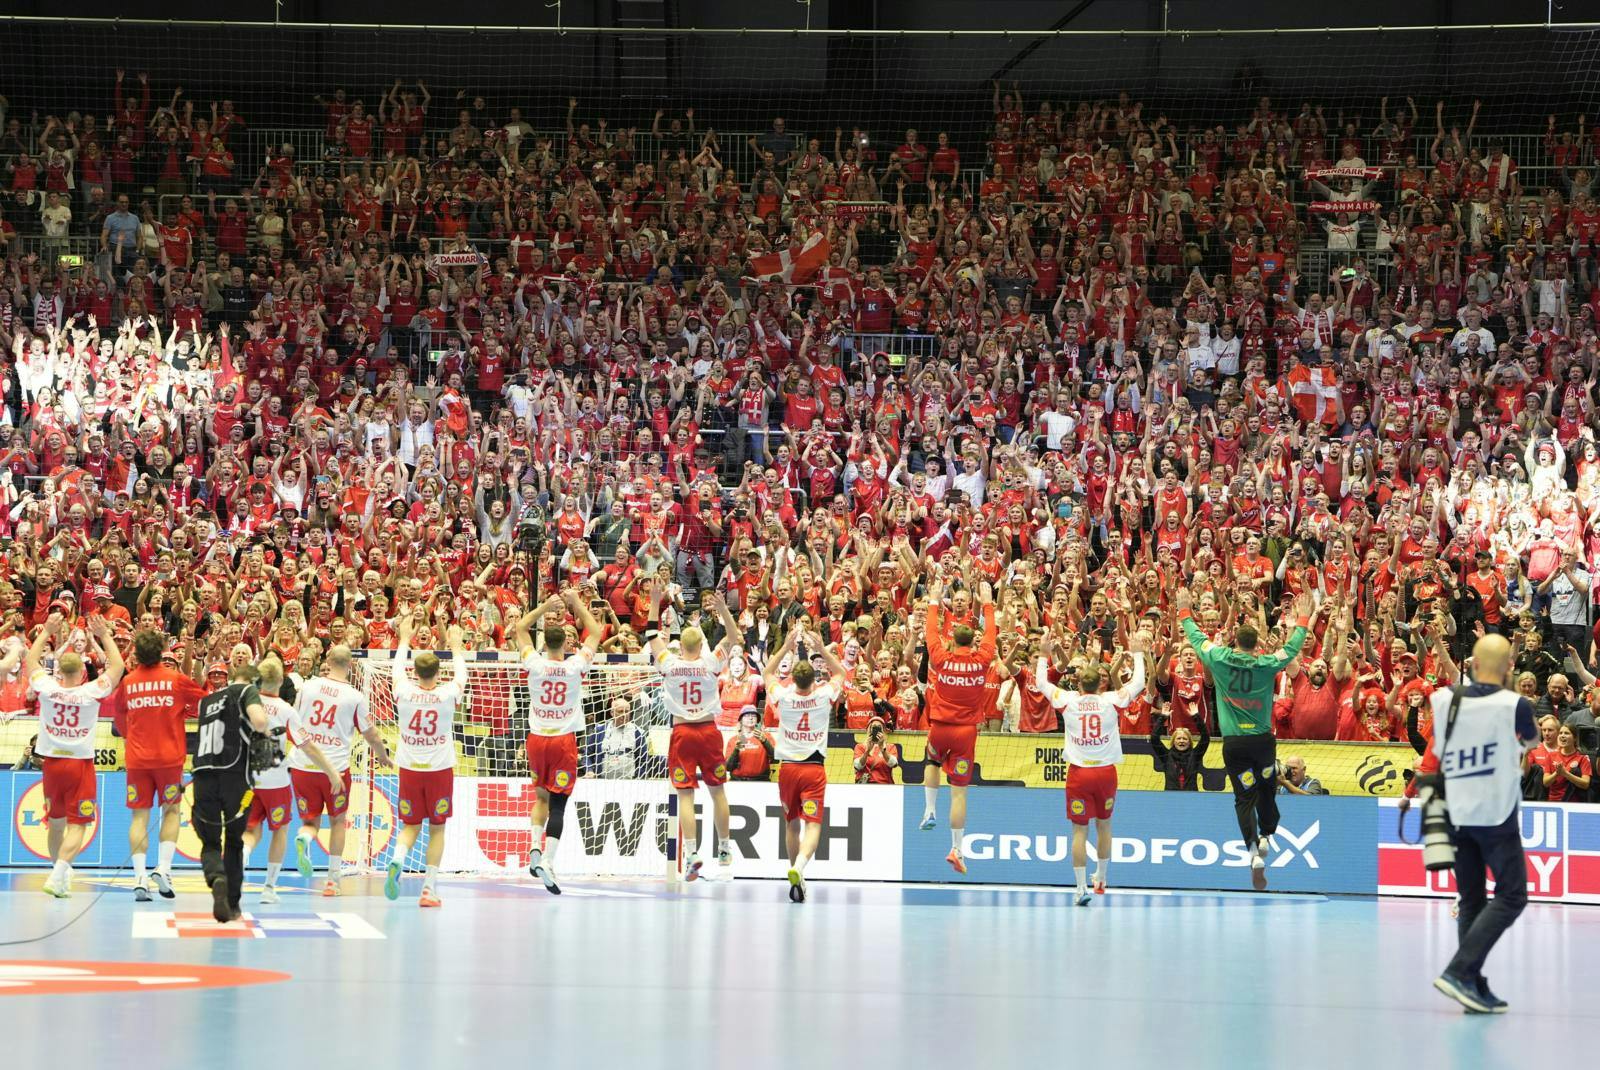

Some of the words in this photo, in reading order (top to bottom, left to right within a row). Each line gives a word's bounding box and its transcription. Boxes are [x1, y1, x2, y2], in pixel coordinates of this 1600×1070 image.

[1319, 167, 1364, 176] DANMARK
[1325, 202, 1375, 211] DANMARK
[938, 674, 985, 687] NORLYS
[1227, 667, 1253, 693] 20
[127, 695, 174, 710] NORLYS
[540, 680, 567, 706] 38
[679, 681, 702, 705] 15
[53, 702, 80, 728] 33
[310, 699, 337, 729] 34
[408, 709, 438, 736] 43
[797, 711, 811, 731] 4
[785, 730, 824, 741] NORLYS
[1079, 714, 1101, 738] 19
[198, 719, 226, 757] HB
[401, 733, 446, 746] NORLYS
[1071, 734, 1109, 747] NORLYS
